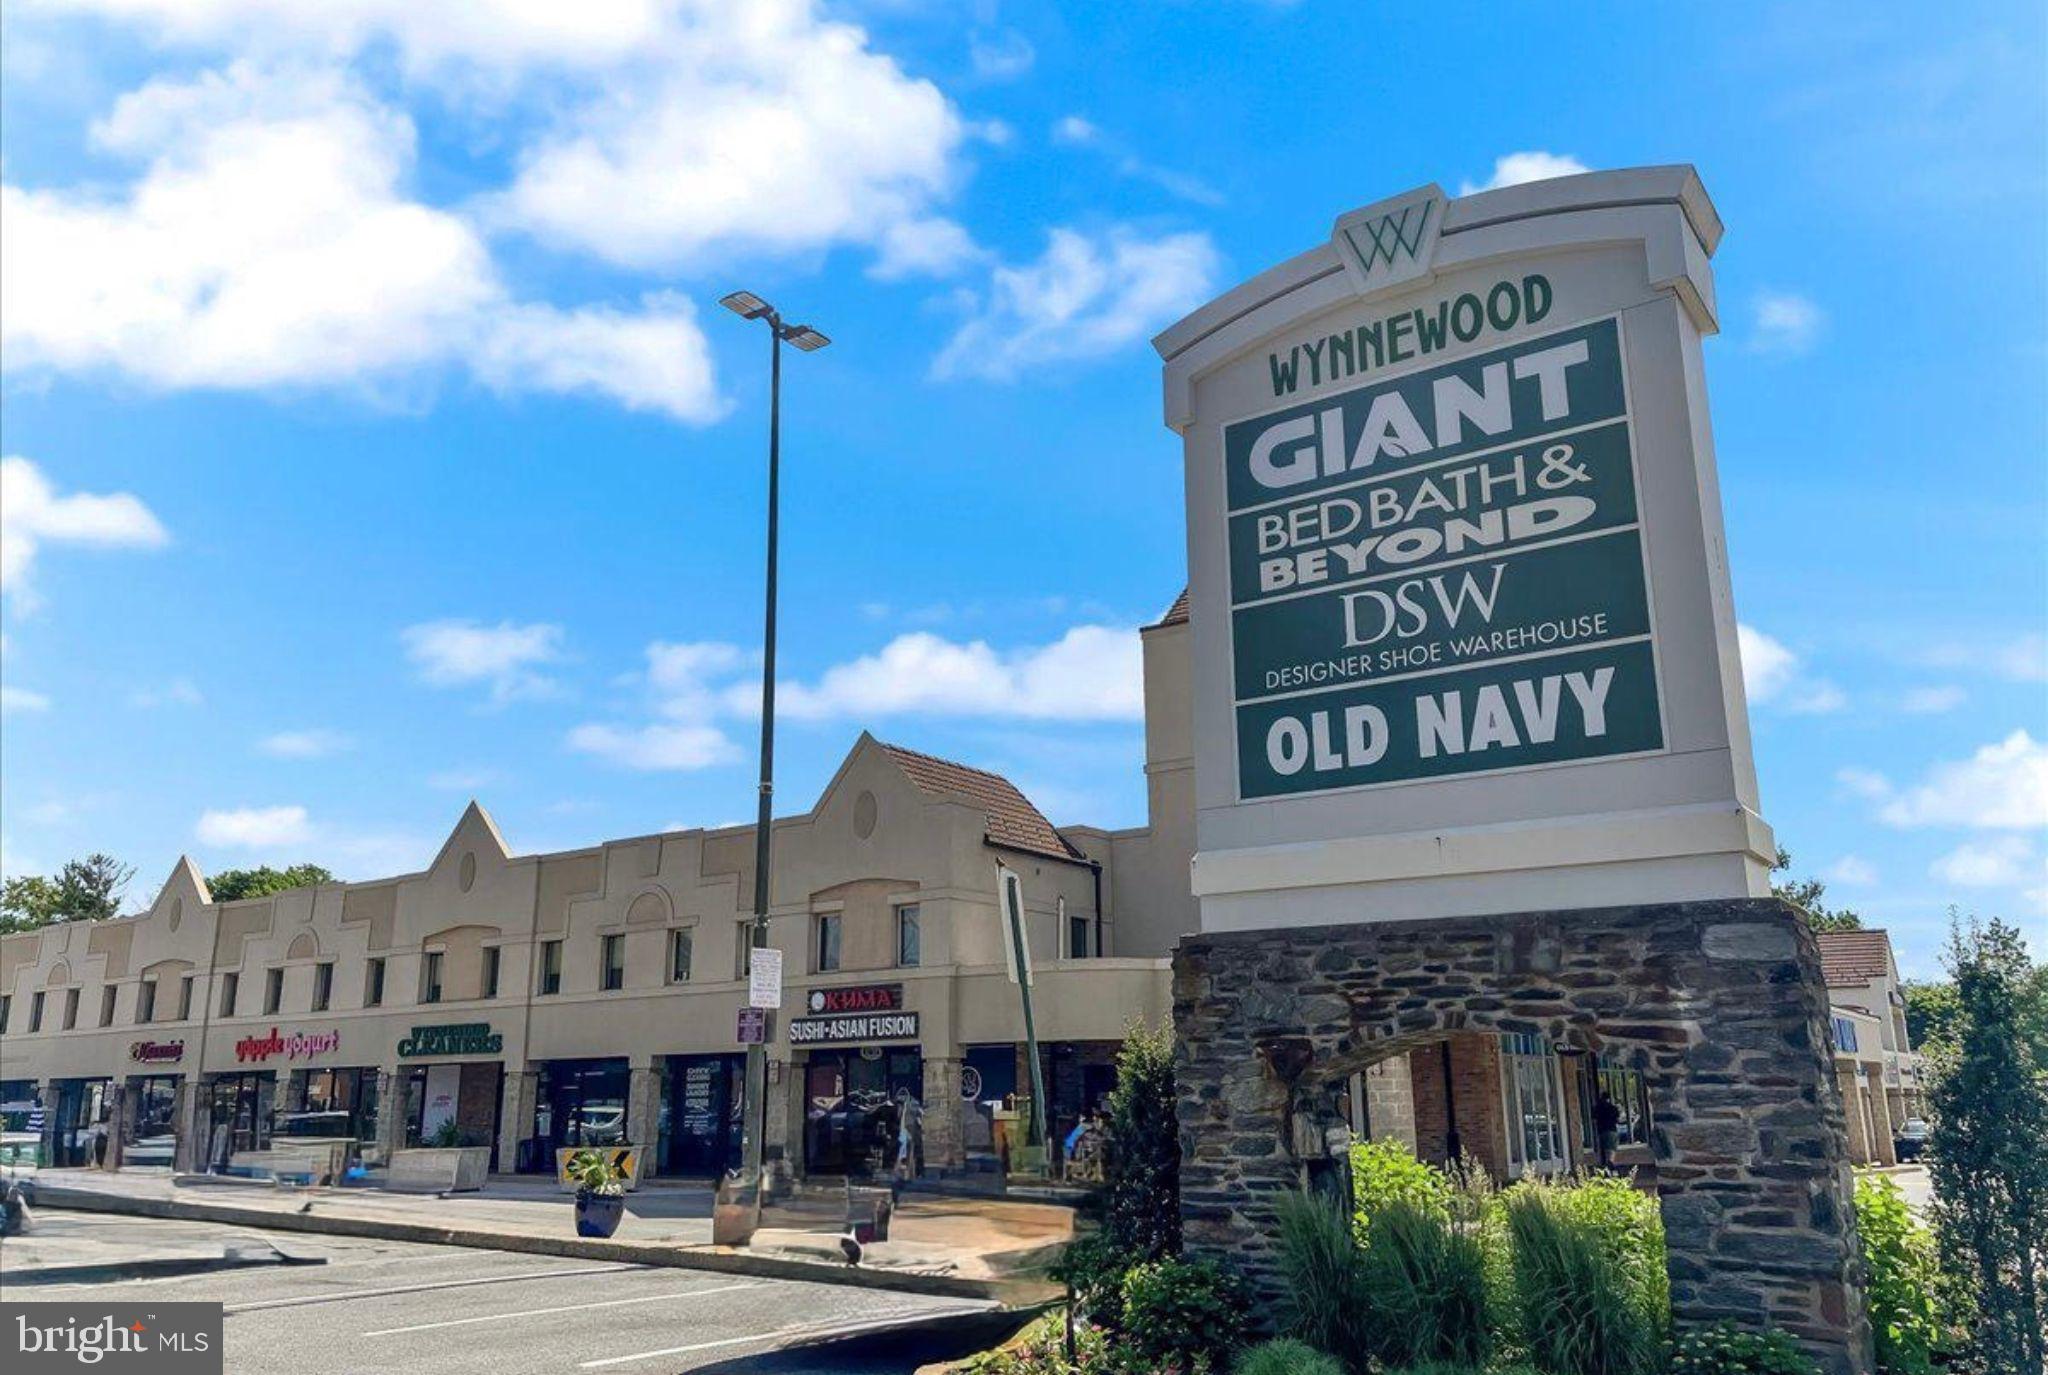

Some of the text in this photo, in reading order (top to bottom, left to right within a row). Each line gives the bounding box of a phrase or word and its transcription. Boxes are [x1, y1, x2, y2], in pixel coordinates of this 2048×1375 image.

[1269, 274, 1553, 396] WYNNEWOOD
[1249, 340, 1589, 488] GIANT
[1259, 443, 1591, 554] BED BATH &
[1260, 495, 1597, 592] BEYOND
[1266, 613, 1608, 688] DESIGNER SHOE WAREHOUSE
[1339, 564, 1508, 648] DSW
[1266, 667, 1615, 777] OLD NAVY
[869, 1016, 915, 1036] FUSION
